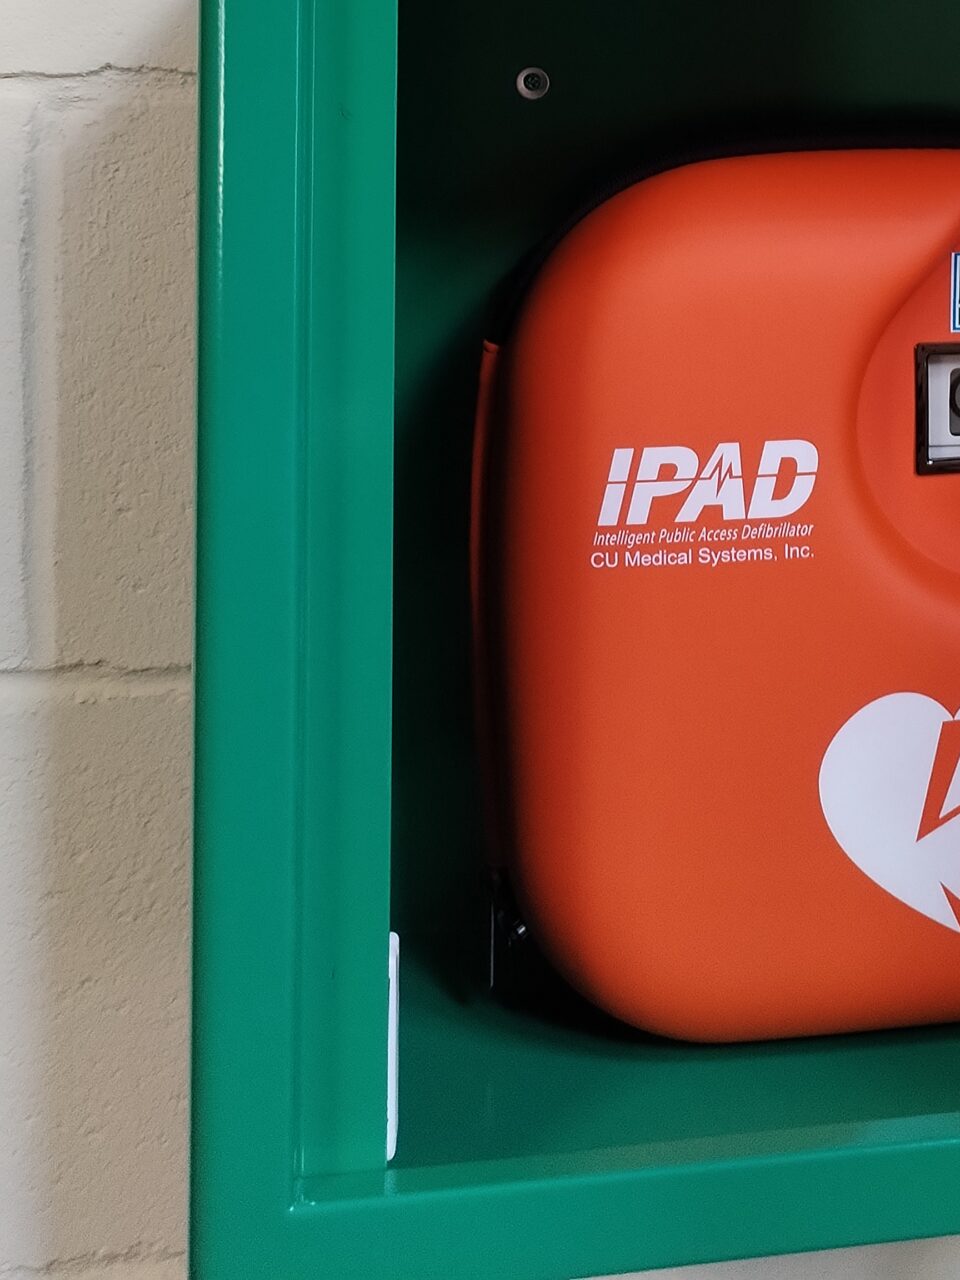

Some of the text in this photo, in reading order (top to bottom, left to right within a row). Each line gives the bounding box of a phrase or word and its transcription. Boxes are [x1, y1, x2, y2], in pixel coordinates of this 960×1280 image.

[598, 439, 819, 526] IPAD
[593, 522, 814, 549] Intelligent Public Access Defibrillator
[590, 543, 815, 568] CU Medical Systems, Inc.
